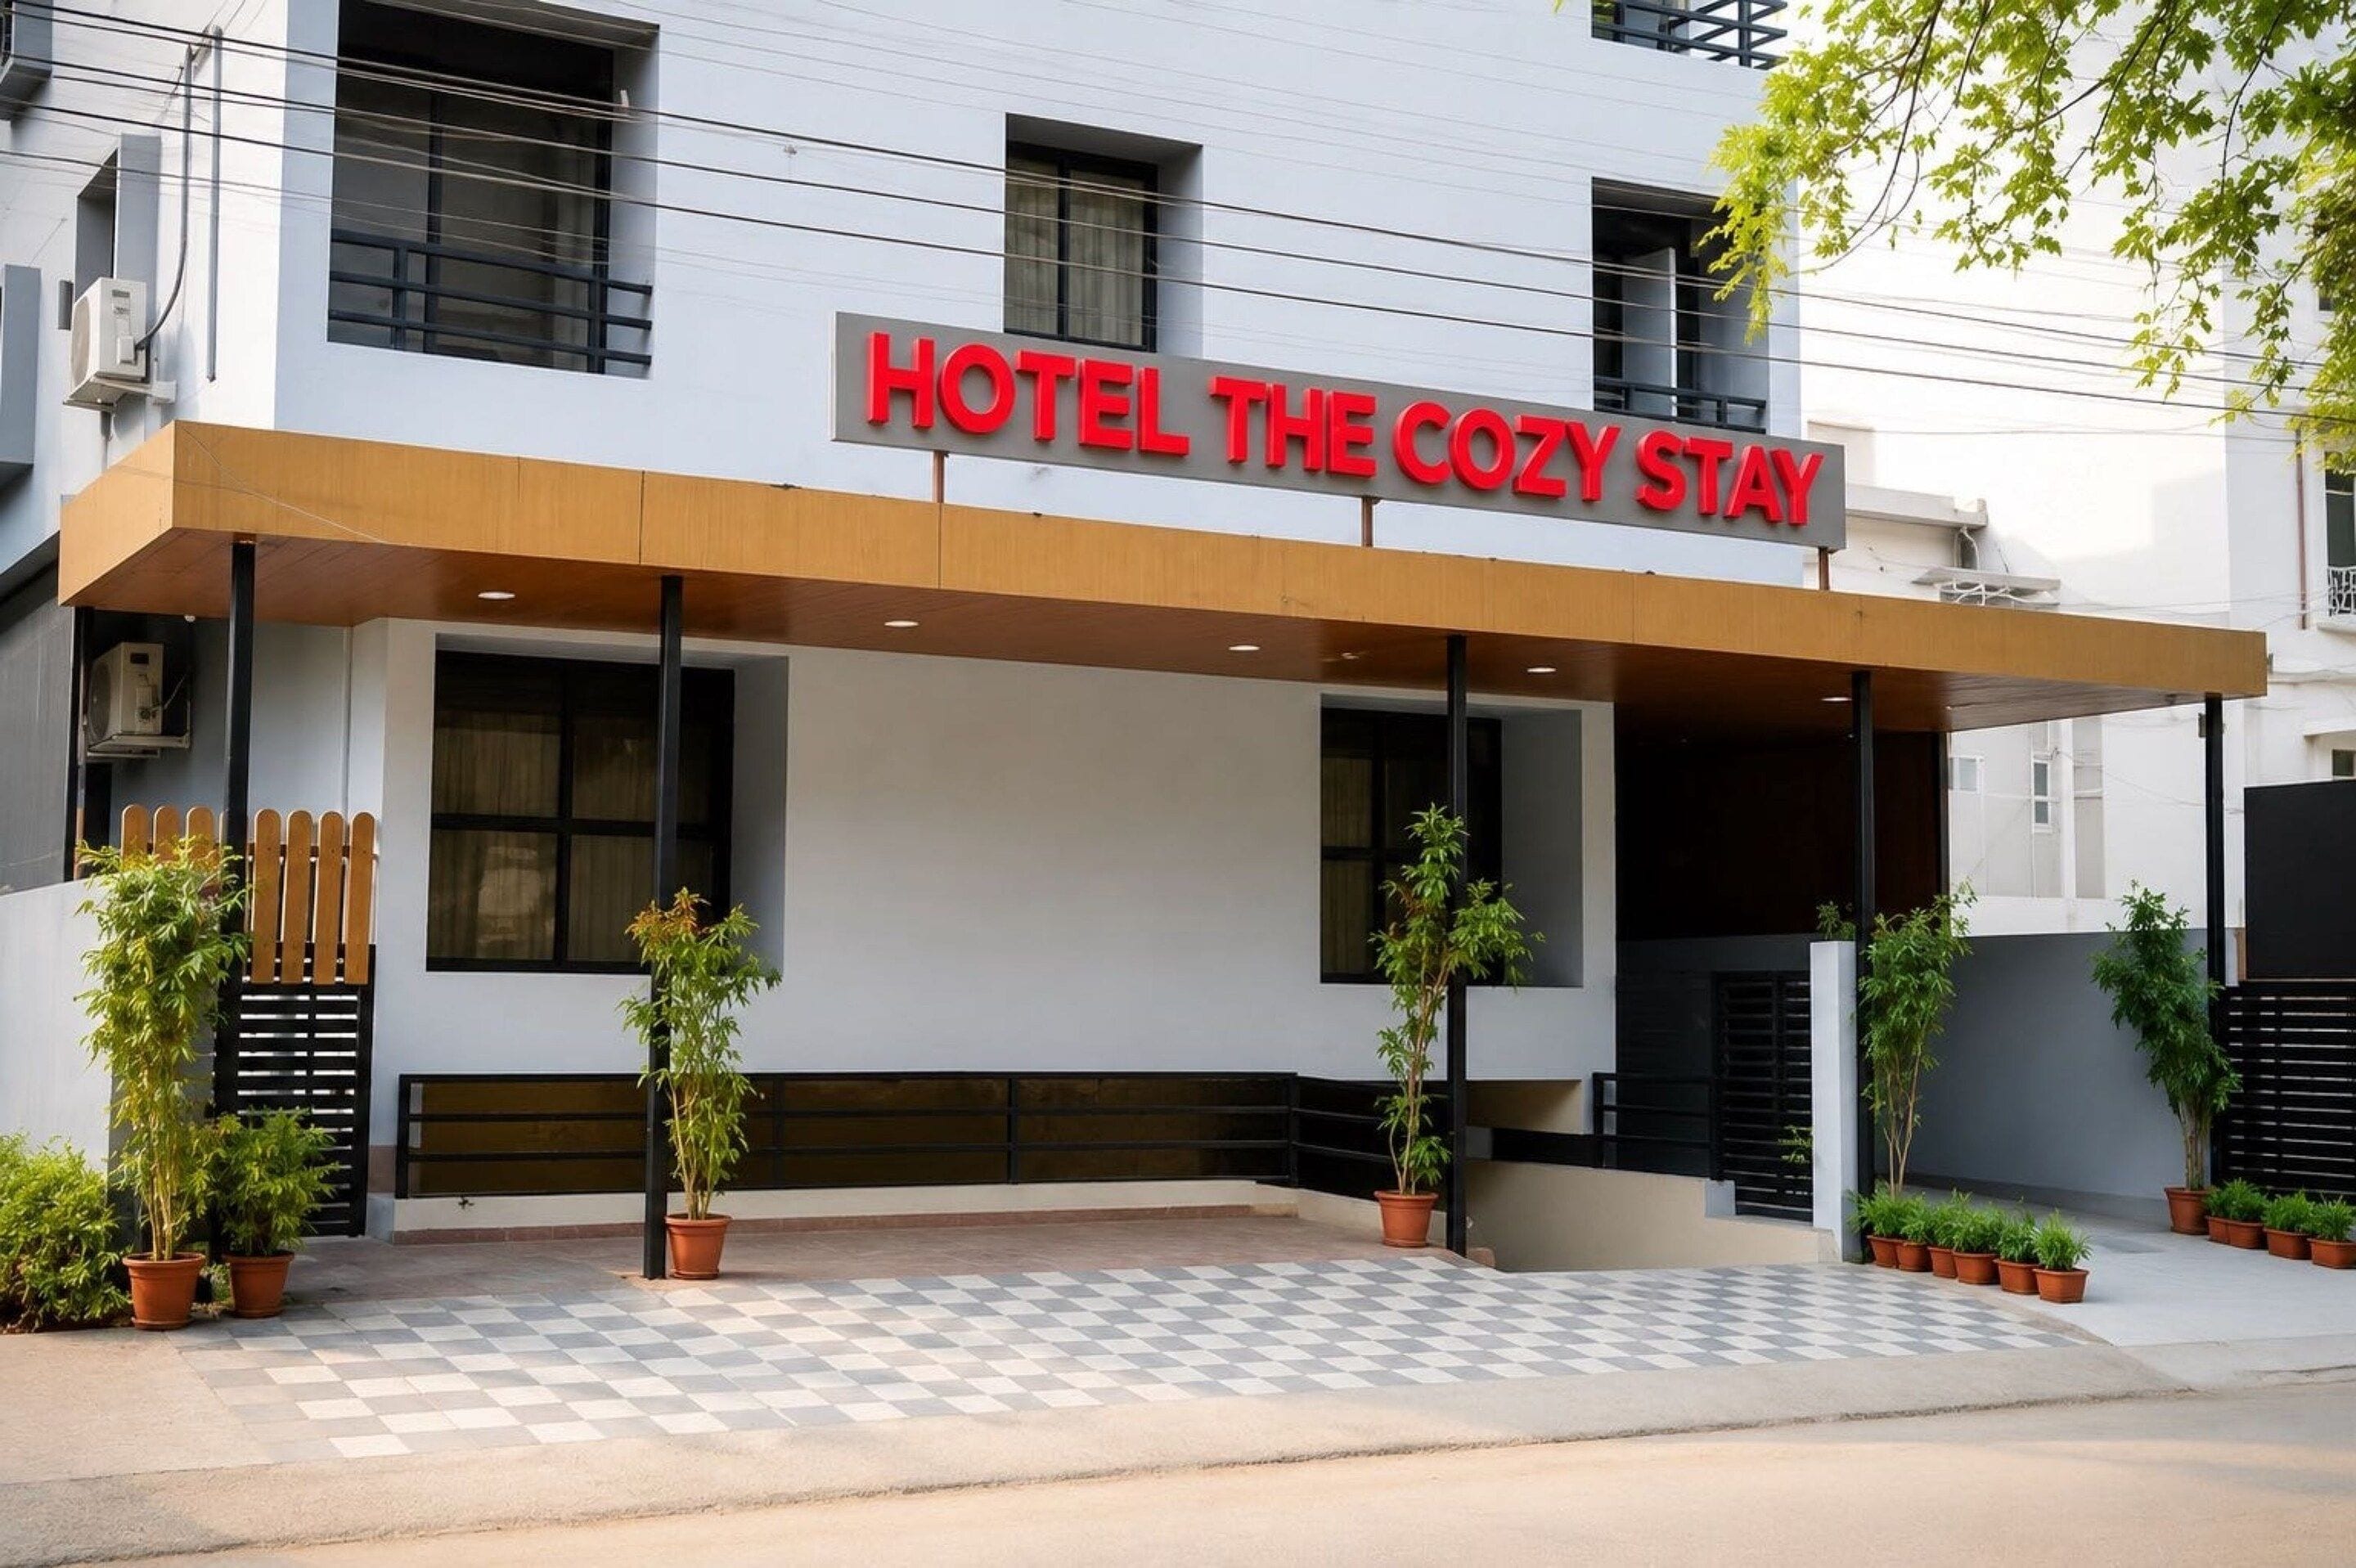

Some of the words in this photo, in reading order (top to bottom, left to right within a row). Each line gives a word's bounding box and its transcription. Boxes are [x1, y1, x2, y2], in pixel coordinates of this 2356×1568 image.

[867, 331, 1190, 458] HOTEL
[1210, 376, 1378, 480] THE
[1392, 401, 1621, 503] COZY
[1635, 429, 1824, 528] STAY
